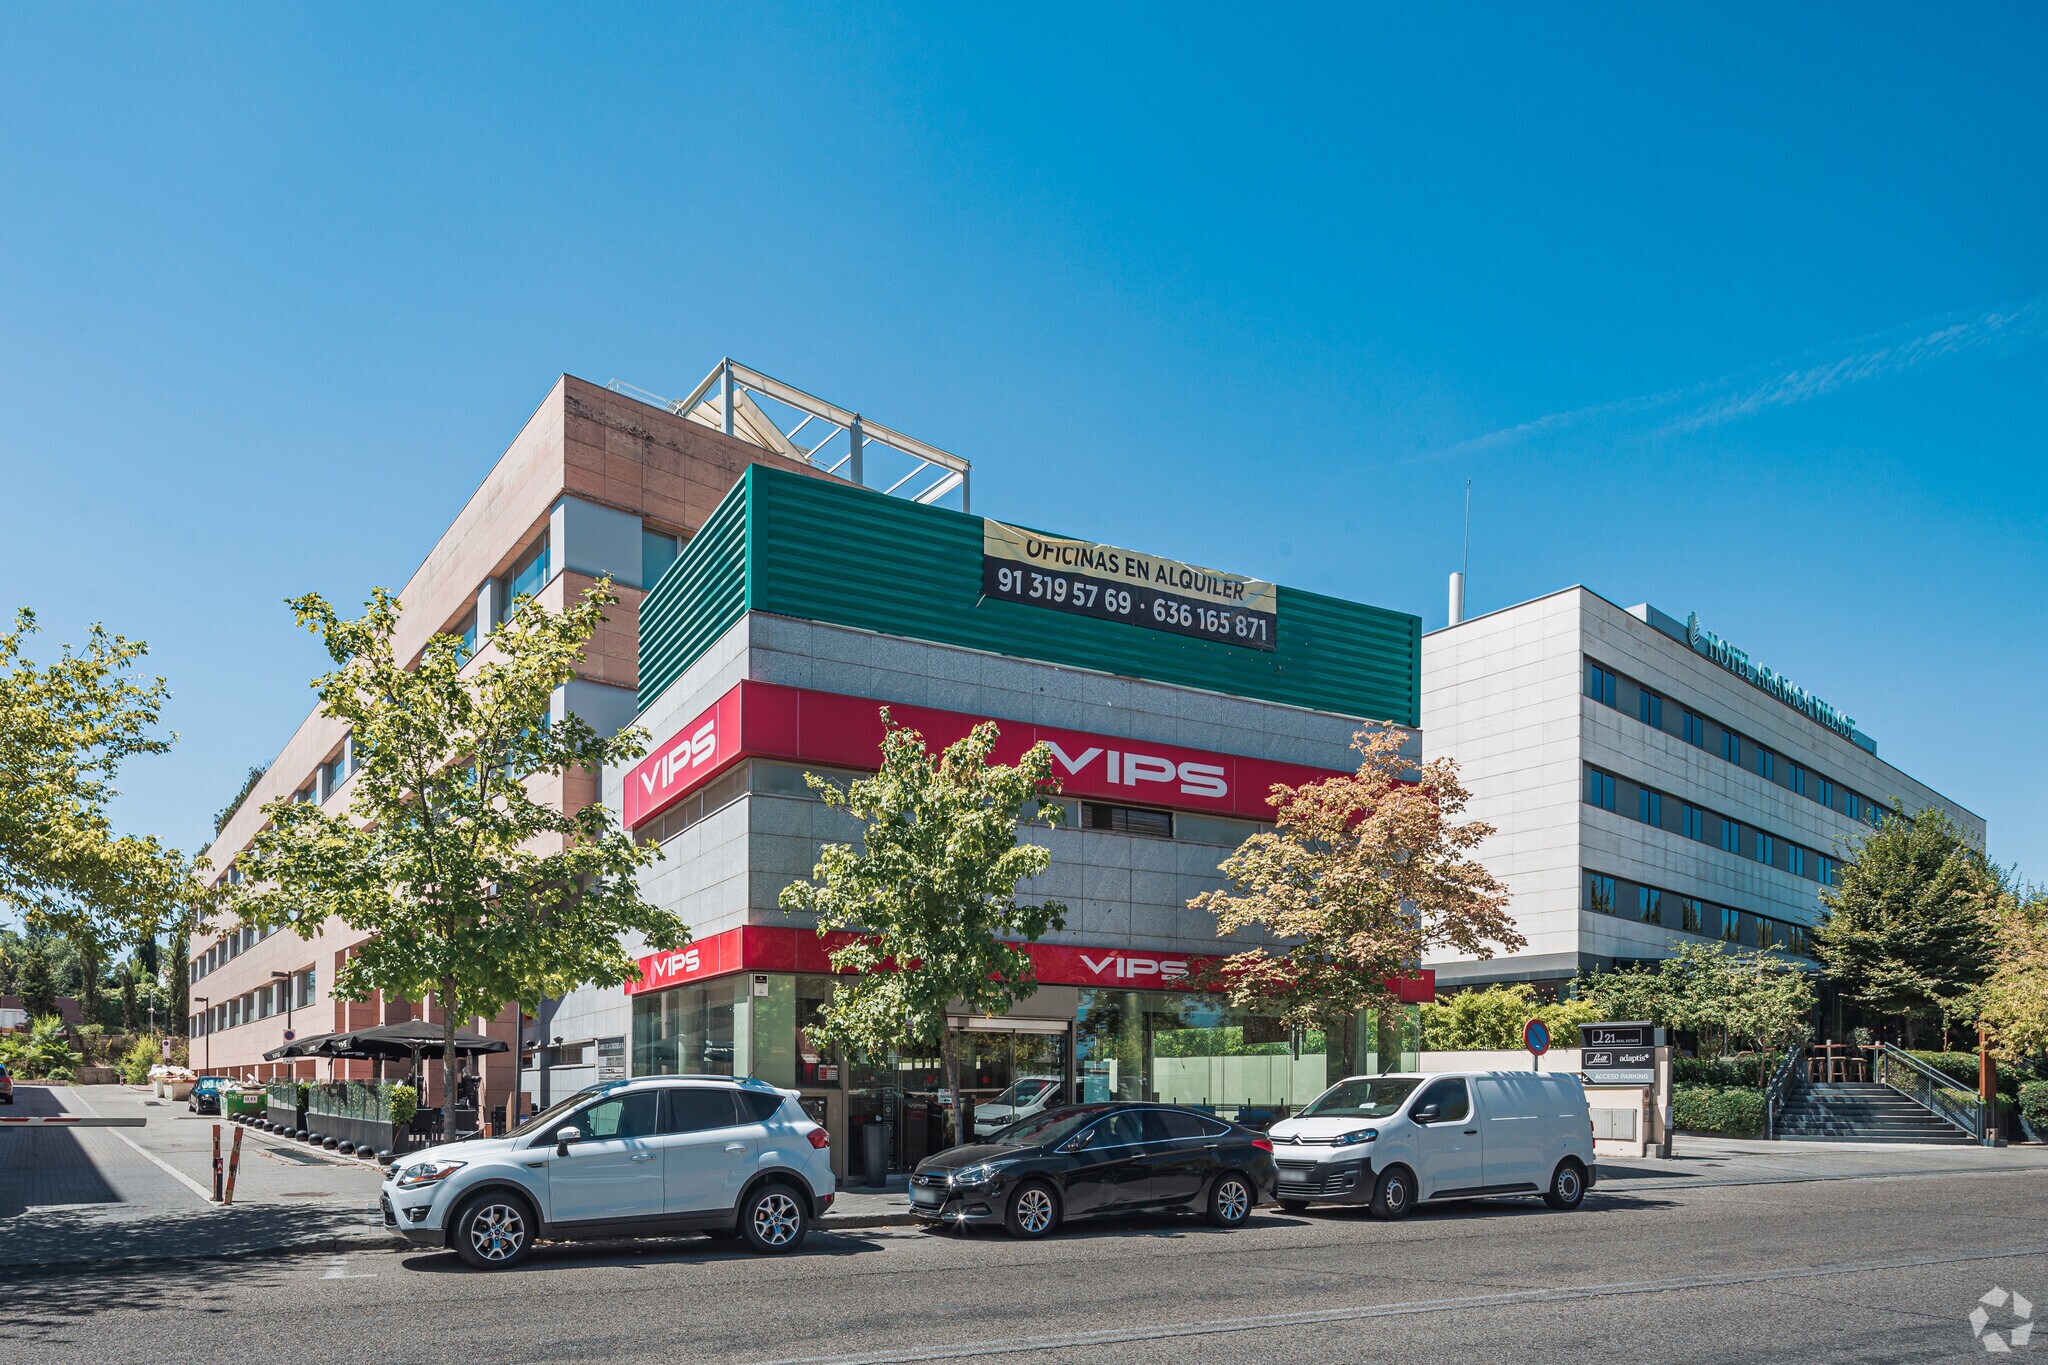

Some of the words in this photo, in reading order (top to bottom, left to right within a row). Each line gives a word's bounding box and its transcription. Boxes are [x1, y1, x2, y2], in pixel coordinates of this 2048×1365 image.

[1025, 539, 1120, 574] OFICINAS
[1125, 557, 1150, 581] EN
[1155, 564, 1245, 601] ALQUILER
[998, 567, 1022, 595] 91
[1029, 572, 1067, 603] 319
[1072, 581, 1098, 608] 57
[1105, 588, 1131, 615] 69
[1152, 598, 1193, 627] 636
[1197, 607, 1230, 634] 165
[1235, 614, 1267, 641] 871
[1707, 630, 1753, 680] HOTEL
[1757, 662, 1812, 716] ARAVACA
[1812, 695, 1856, 740] VILLAGE
[640, 718, 717, 796] VIPS
[1044, 740, 1228, 798] VIPS
[653, 948, 701, 978] VIPS
[1079, 954, 1190, 981] VIPS
[1619, 1053, 1645, 1063] adaptis
